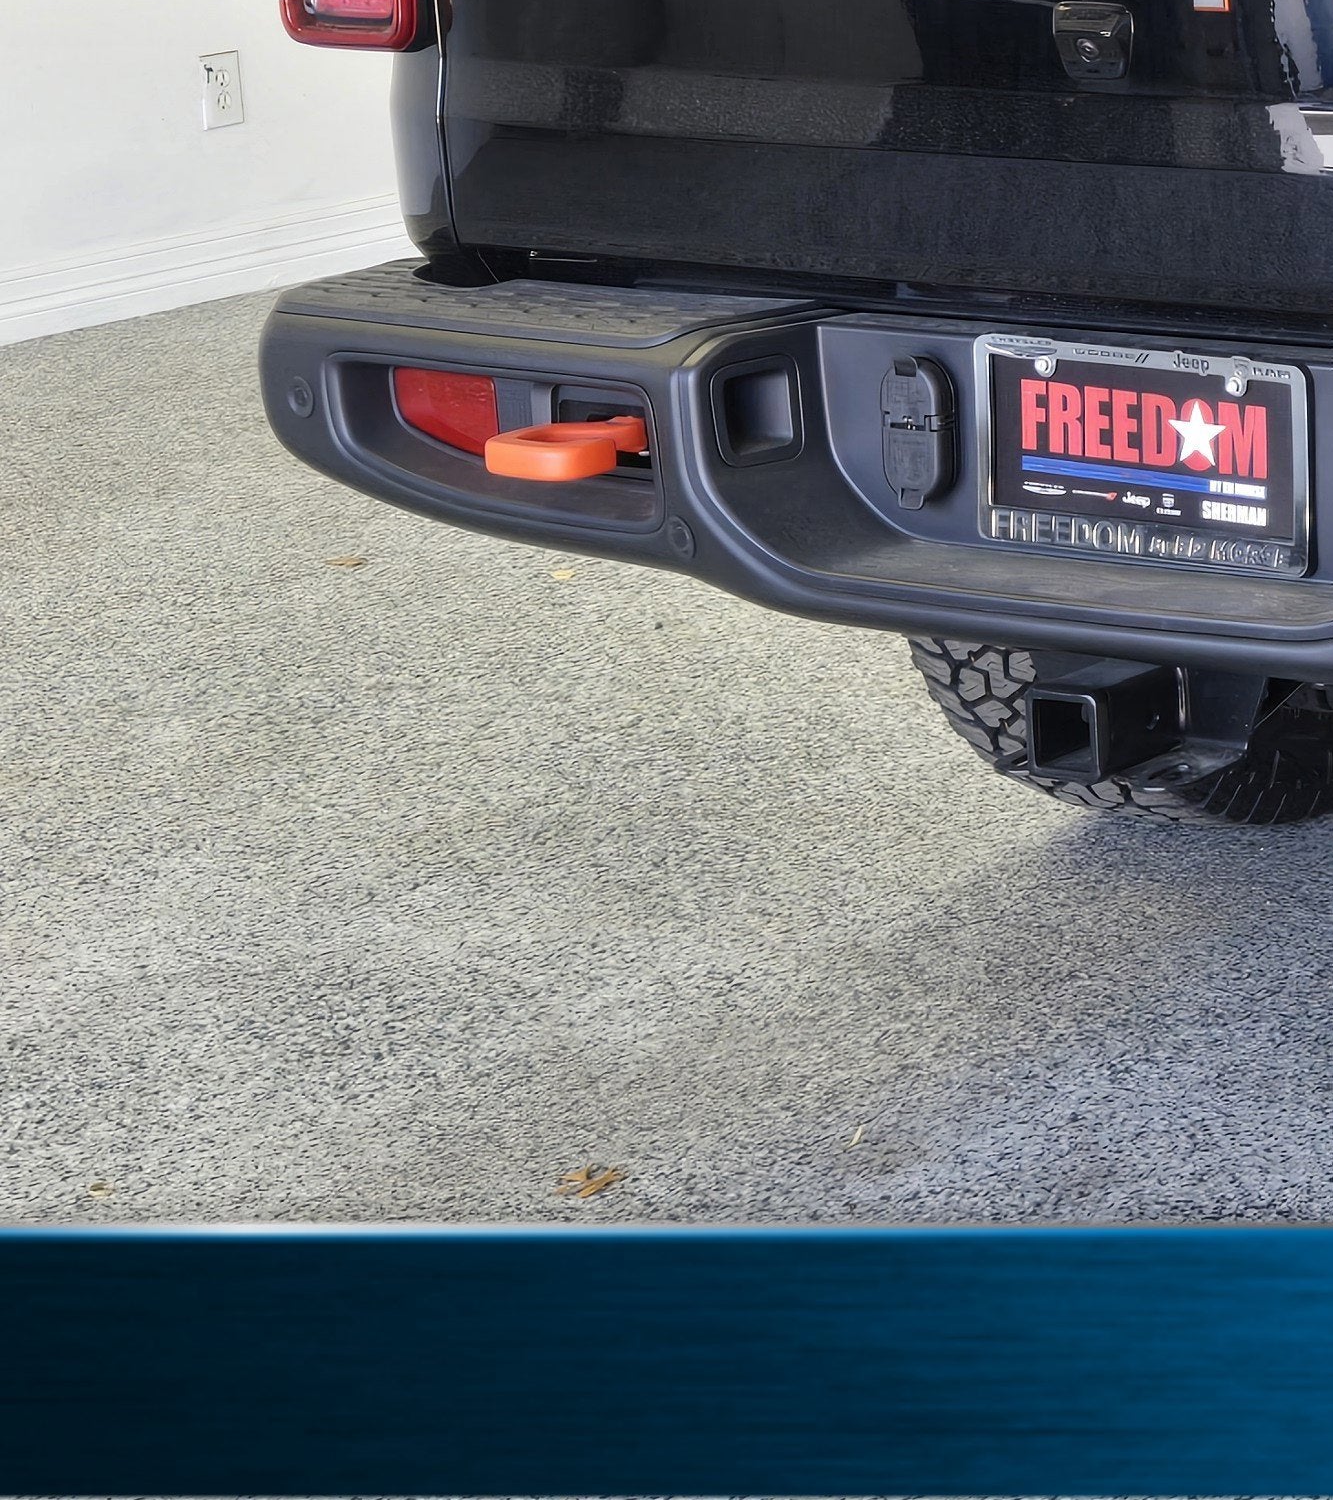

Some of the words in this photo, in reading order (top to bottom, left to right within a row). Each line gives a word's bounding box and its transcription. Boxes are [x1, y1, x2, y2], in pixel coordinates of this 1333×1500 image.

[1173, 352, 1210, 374] Jeep
[1019, 378, 1268, 480] FREEDOM
[990, 508, 1142, 556] FREEDOM
[1201, 499, 1267, 527] SHERMAN
